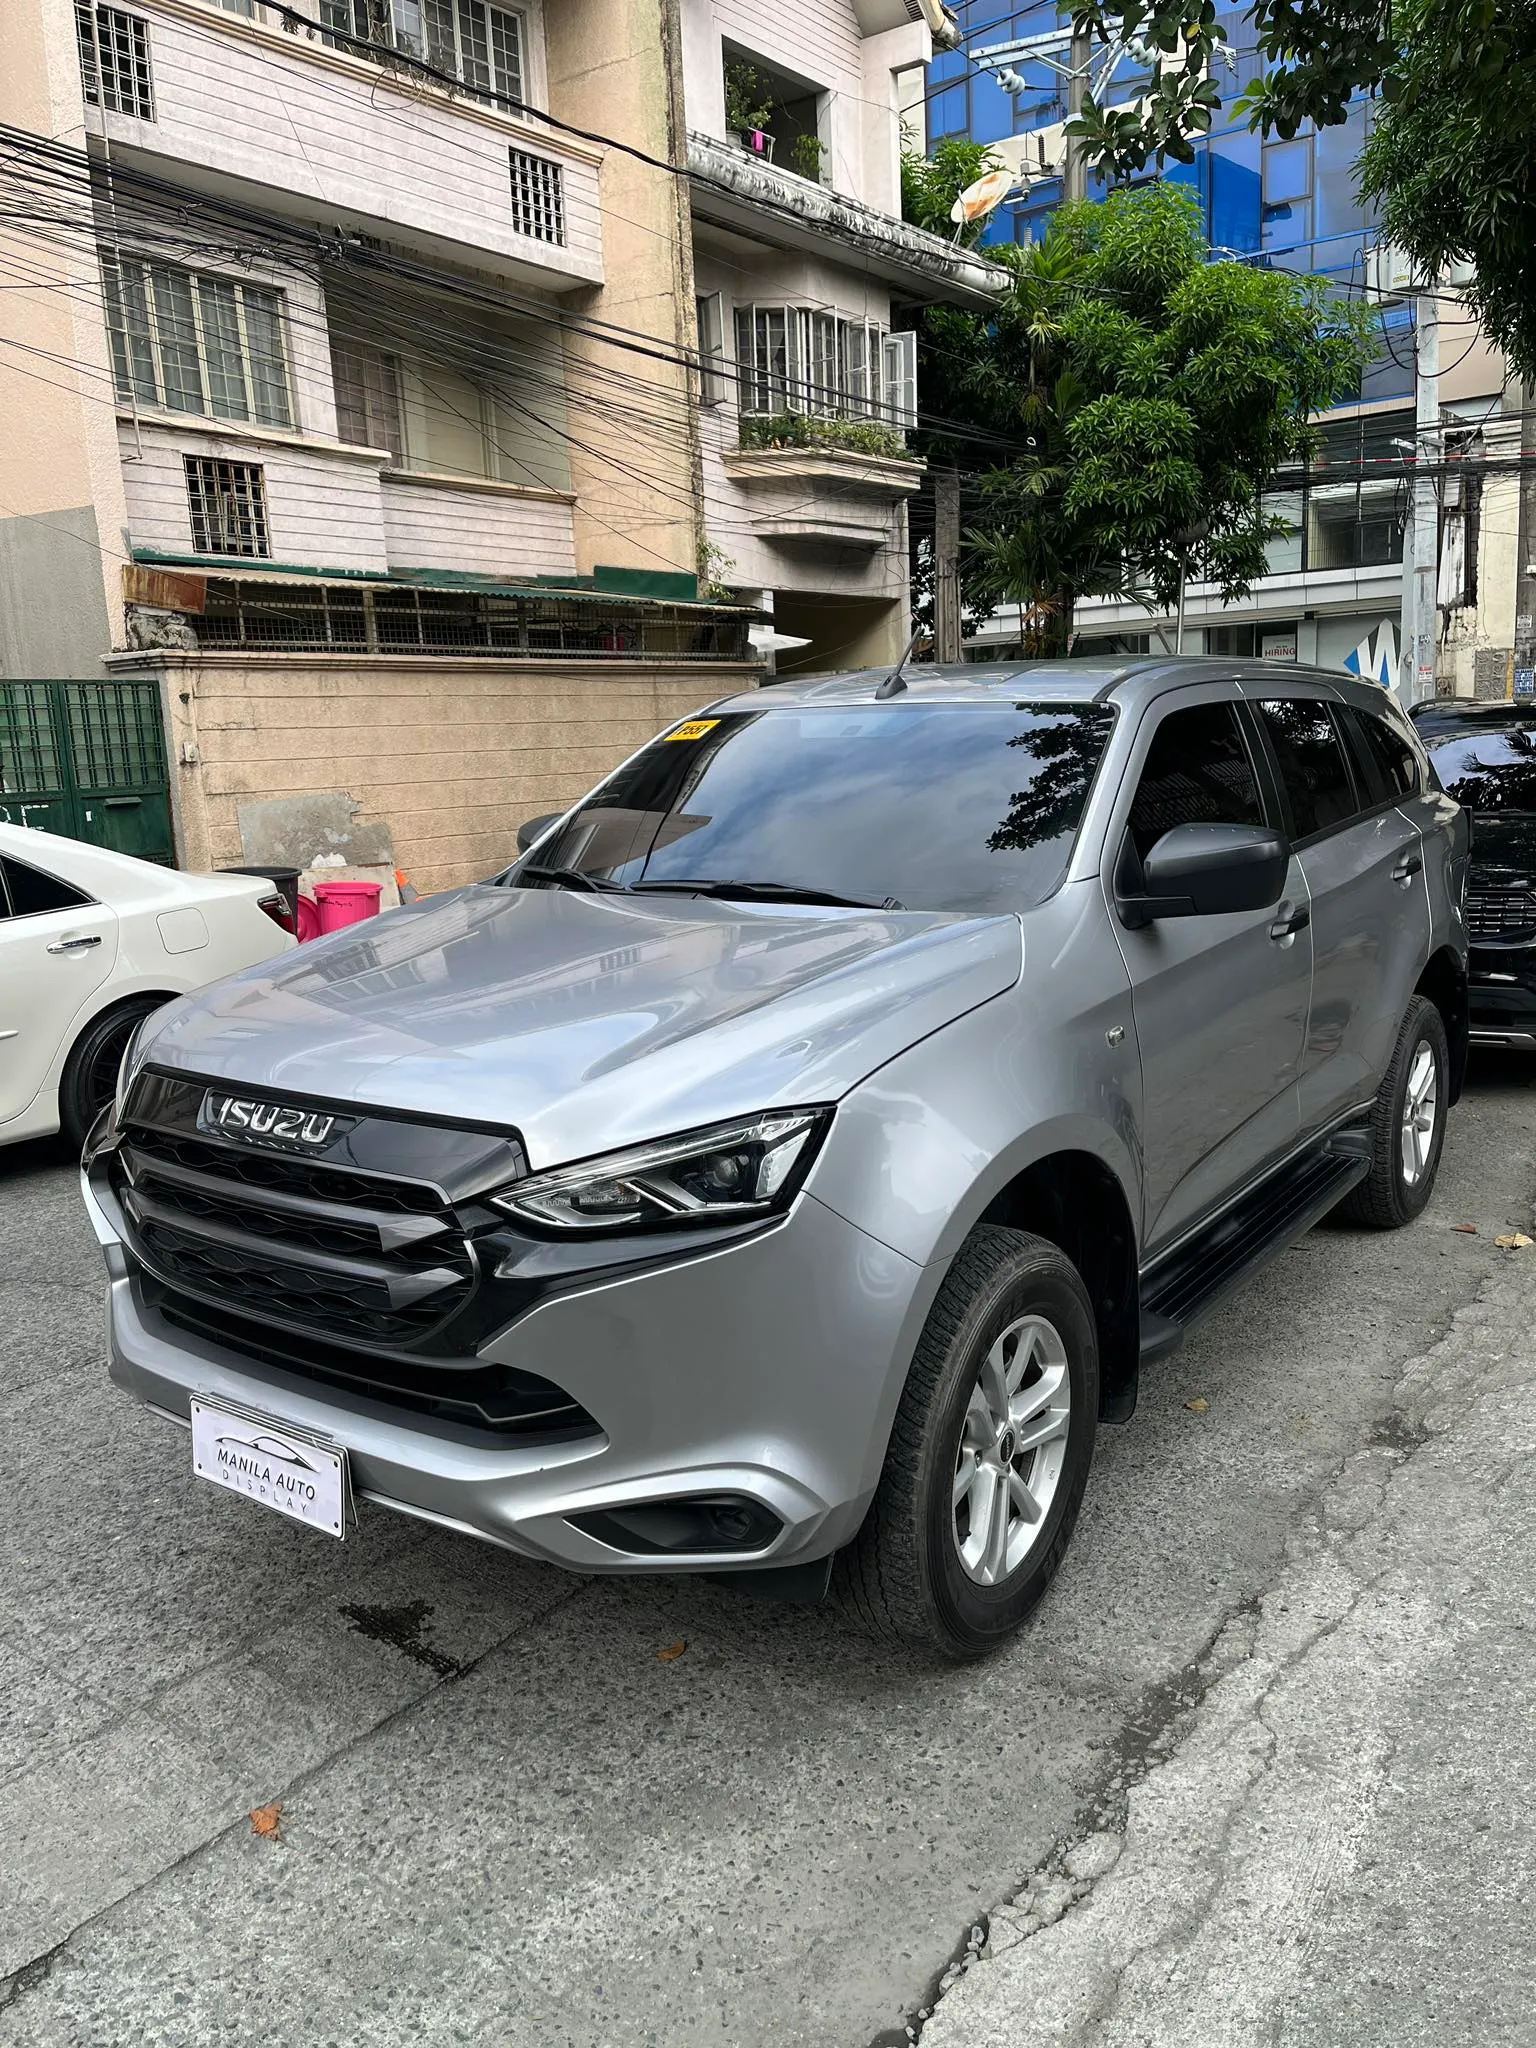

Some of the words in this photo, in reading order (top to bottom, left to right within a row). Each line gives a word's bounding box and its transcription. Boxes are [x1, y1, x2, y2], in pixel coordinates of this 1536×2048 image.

[1265, 647, 1296, 657] HIRING
[219, 1097, 334, 1143] ISUZU
[217, 1448, 271, 1482] MANILA
[276, 1473, 316, 1500] AUTO
[222, 1469, 308, 1513] DISPLAY
